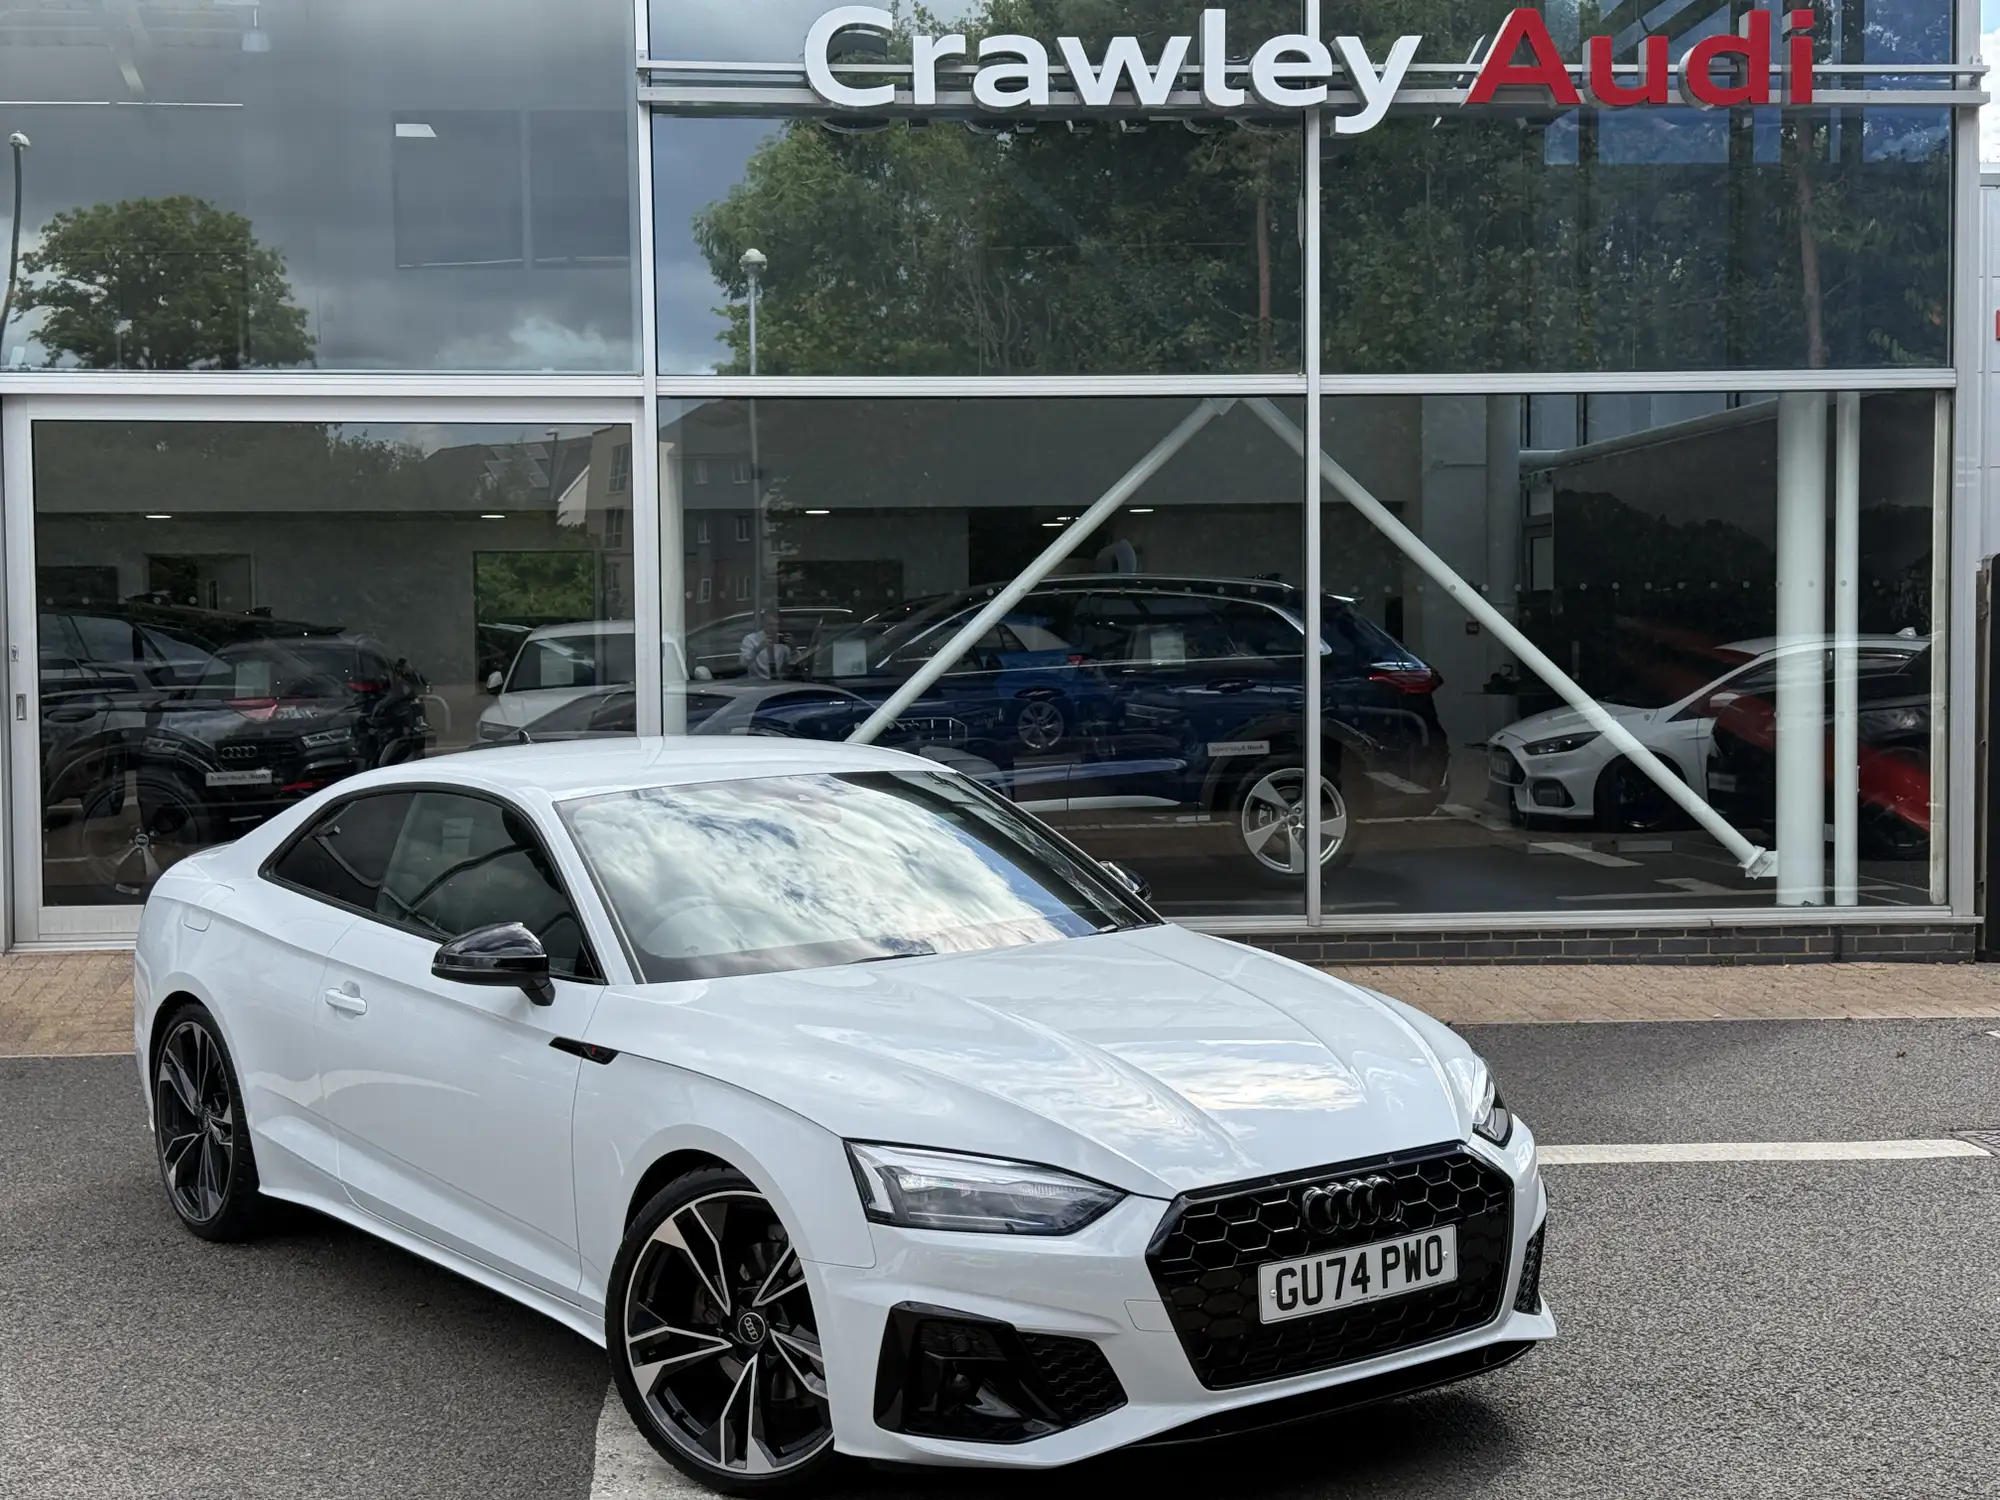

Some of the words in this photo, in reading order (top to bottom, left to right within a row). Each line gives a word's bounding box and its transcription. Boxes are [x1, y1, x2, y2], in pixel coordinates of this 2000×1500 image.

[804, 5, 1422, 134] Crawley
[1464, 7, 1814, 106] Audi
[1276, 1252, 1370, 1311] GU74
[1382, 1235, 1443, 1289] PWO
